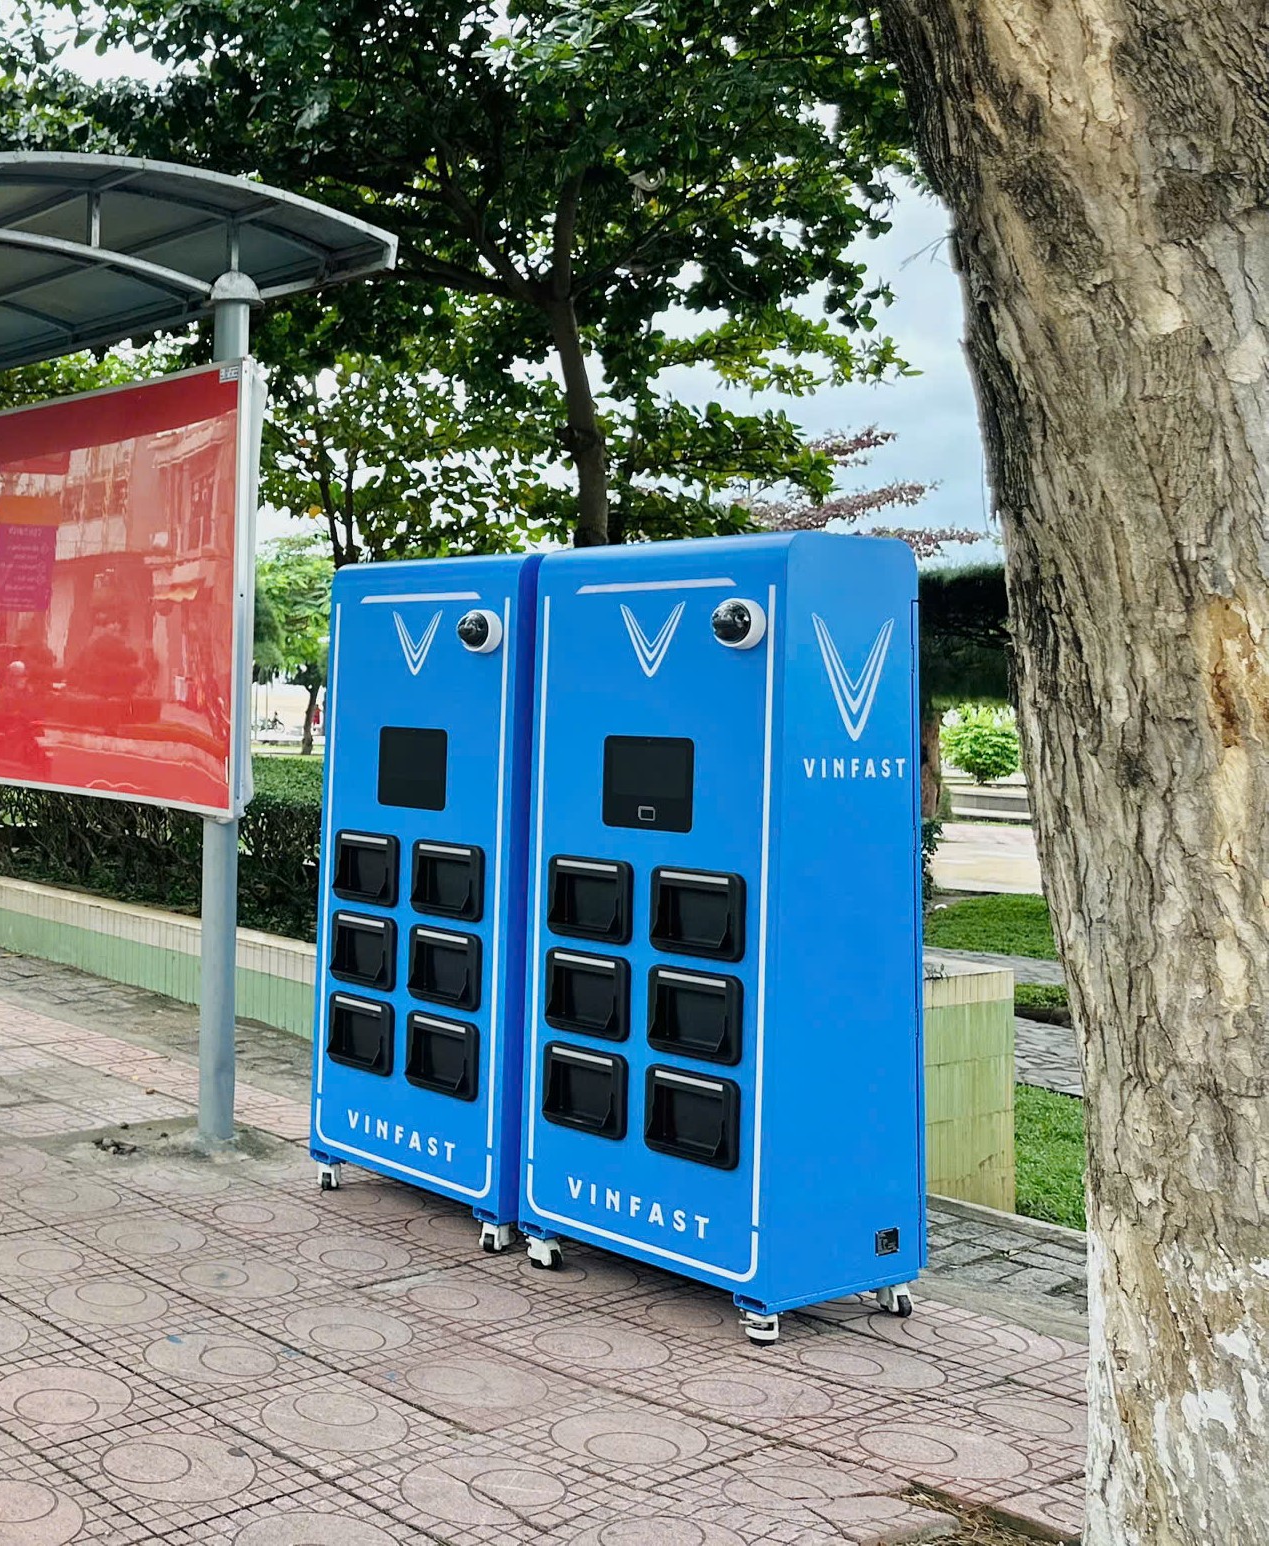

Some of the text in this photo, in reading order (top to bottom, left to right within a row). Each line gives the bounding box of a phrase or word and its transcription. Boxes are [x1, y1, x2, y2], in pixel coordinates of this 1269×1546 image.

[803, 758, 906, 779] VINFAST
[347, 1108, 456, 1162] VINFAST
[567, 1176, 710, 1239] VINFAST
